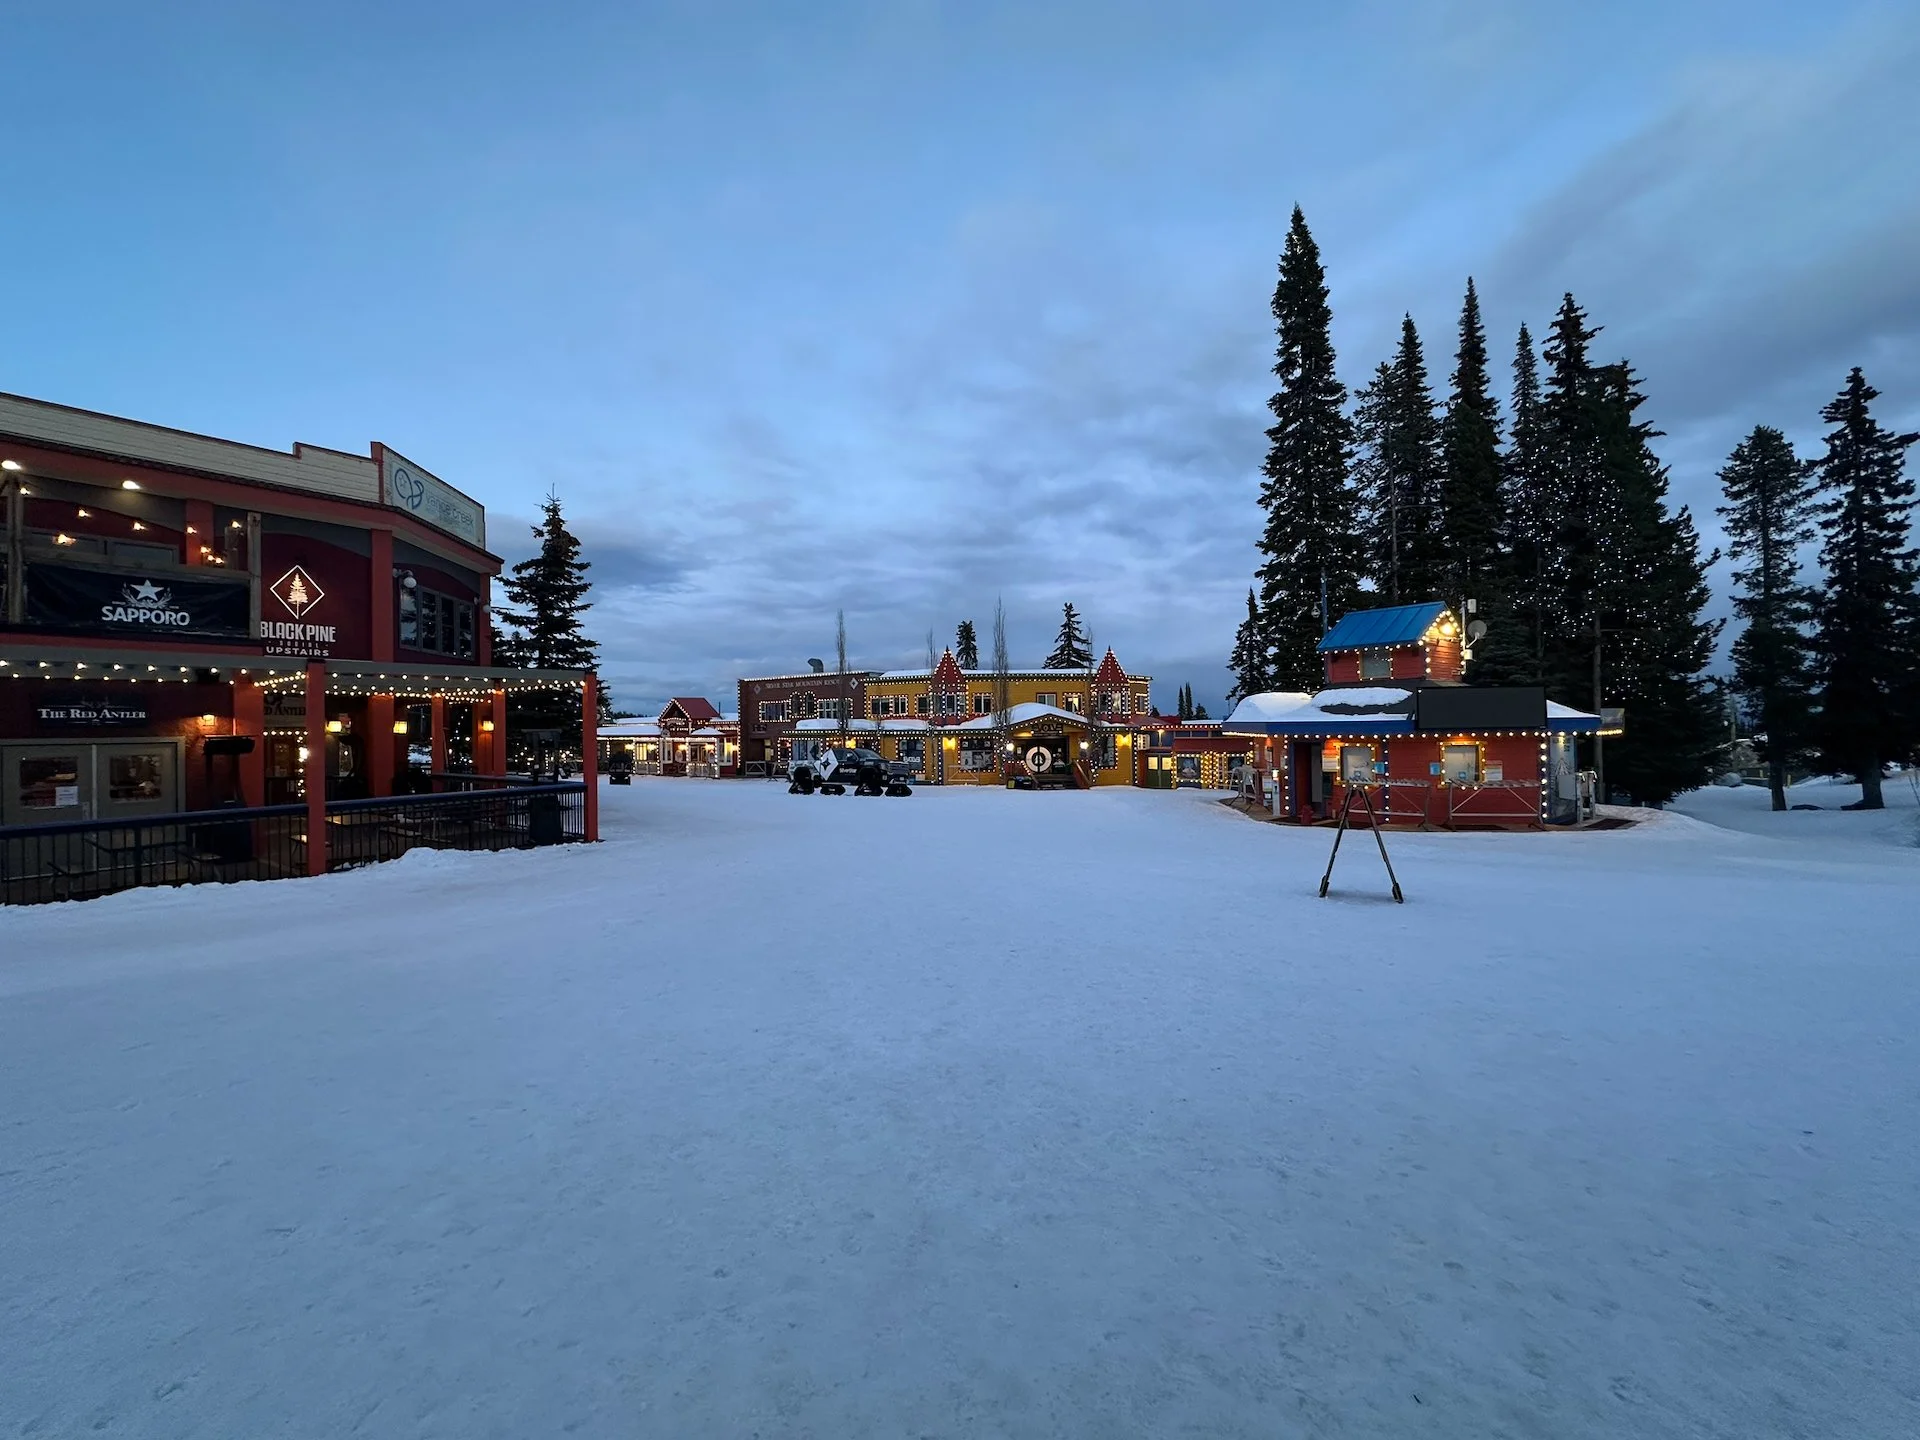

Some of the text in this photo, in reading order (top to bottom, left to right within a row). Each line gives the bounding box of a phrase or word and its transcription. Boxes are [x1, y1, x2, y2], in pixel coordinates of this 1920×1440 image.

[101, 605, 190, 626] SAPPORO
[260, 621, 336, 643] BLACK PINE
[266, 646, 330, 657] UPSTAIRS
